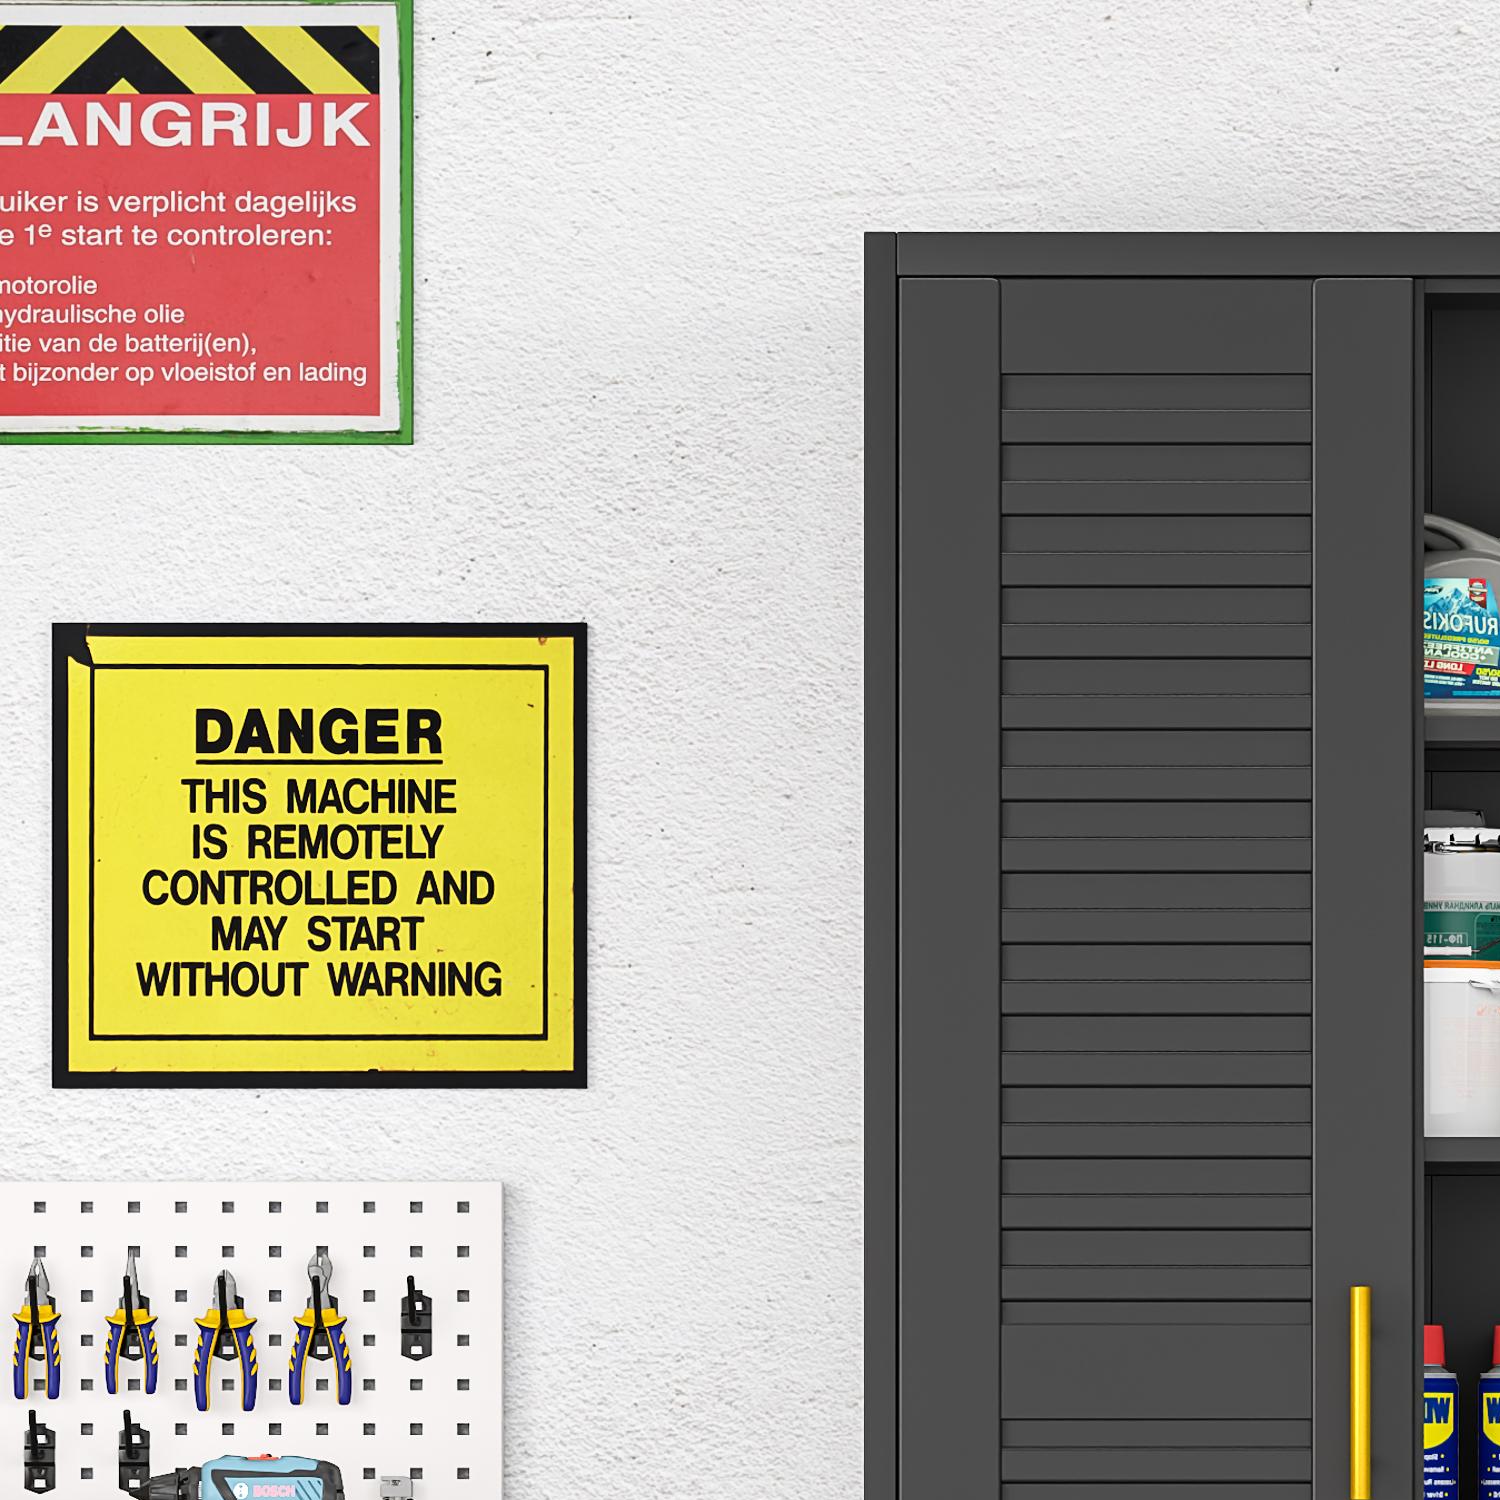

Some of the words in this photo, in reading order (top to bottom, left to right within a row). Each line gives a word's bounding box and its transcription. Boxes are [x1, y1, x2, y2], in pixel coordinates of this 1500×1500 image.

[0, 190, 68, 213] uiker
[77, 190, 99, 213] is
[108, 190, 226, 219] verplicht
[235, 190, 357, 219] dagelijks
[0, 228, 14, 246] e
[61, 225, 123, 246] start
[132, 225, 158, 246] te
[167, 224, 333, 246] controleren:
[144, 304, 185, 324] olie
[39, 337, 81, 352] van
[88, 333, 118, 352] de
[125, 333, 257, 358] batterij(en),
[13, 362, 119, 386] bijzonder
[125, 367, 155, 387] op
[161, 362, 257, 382] vloeistof
[263, 367, 292, 382] en
[299, 362, 368, 387] lading
[195, 708, 443, 754] DANGER
[181, 778, 267, 814] THIS
[287, 778, 457, 814] MACHINE
[192, 824, 228, 860] IS
[247, 824, 444, 860] REMOTELY
[142, 869, 398, 906] CONTROLLED
[416, 869, 496, 906] AND
[211, 916, 288, 951] MAY
[307, 915, 425, 952] START
[136, 961, 309, 997] WITHOUT
[327, 961, 503, 998] WARNING
[253, 1485, 297, 1497] BOSCH
